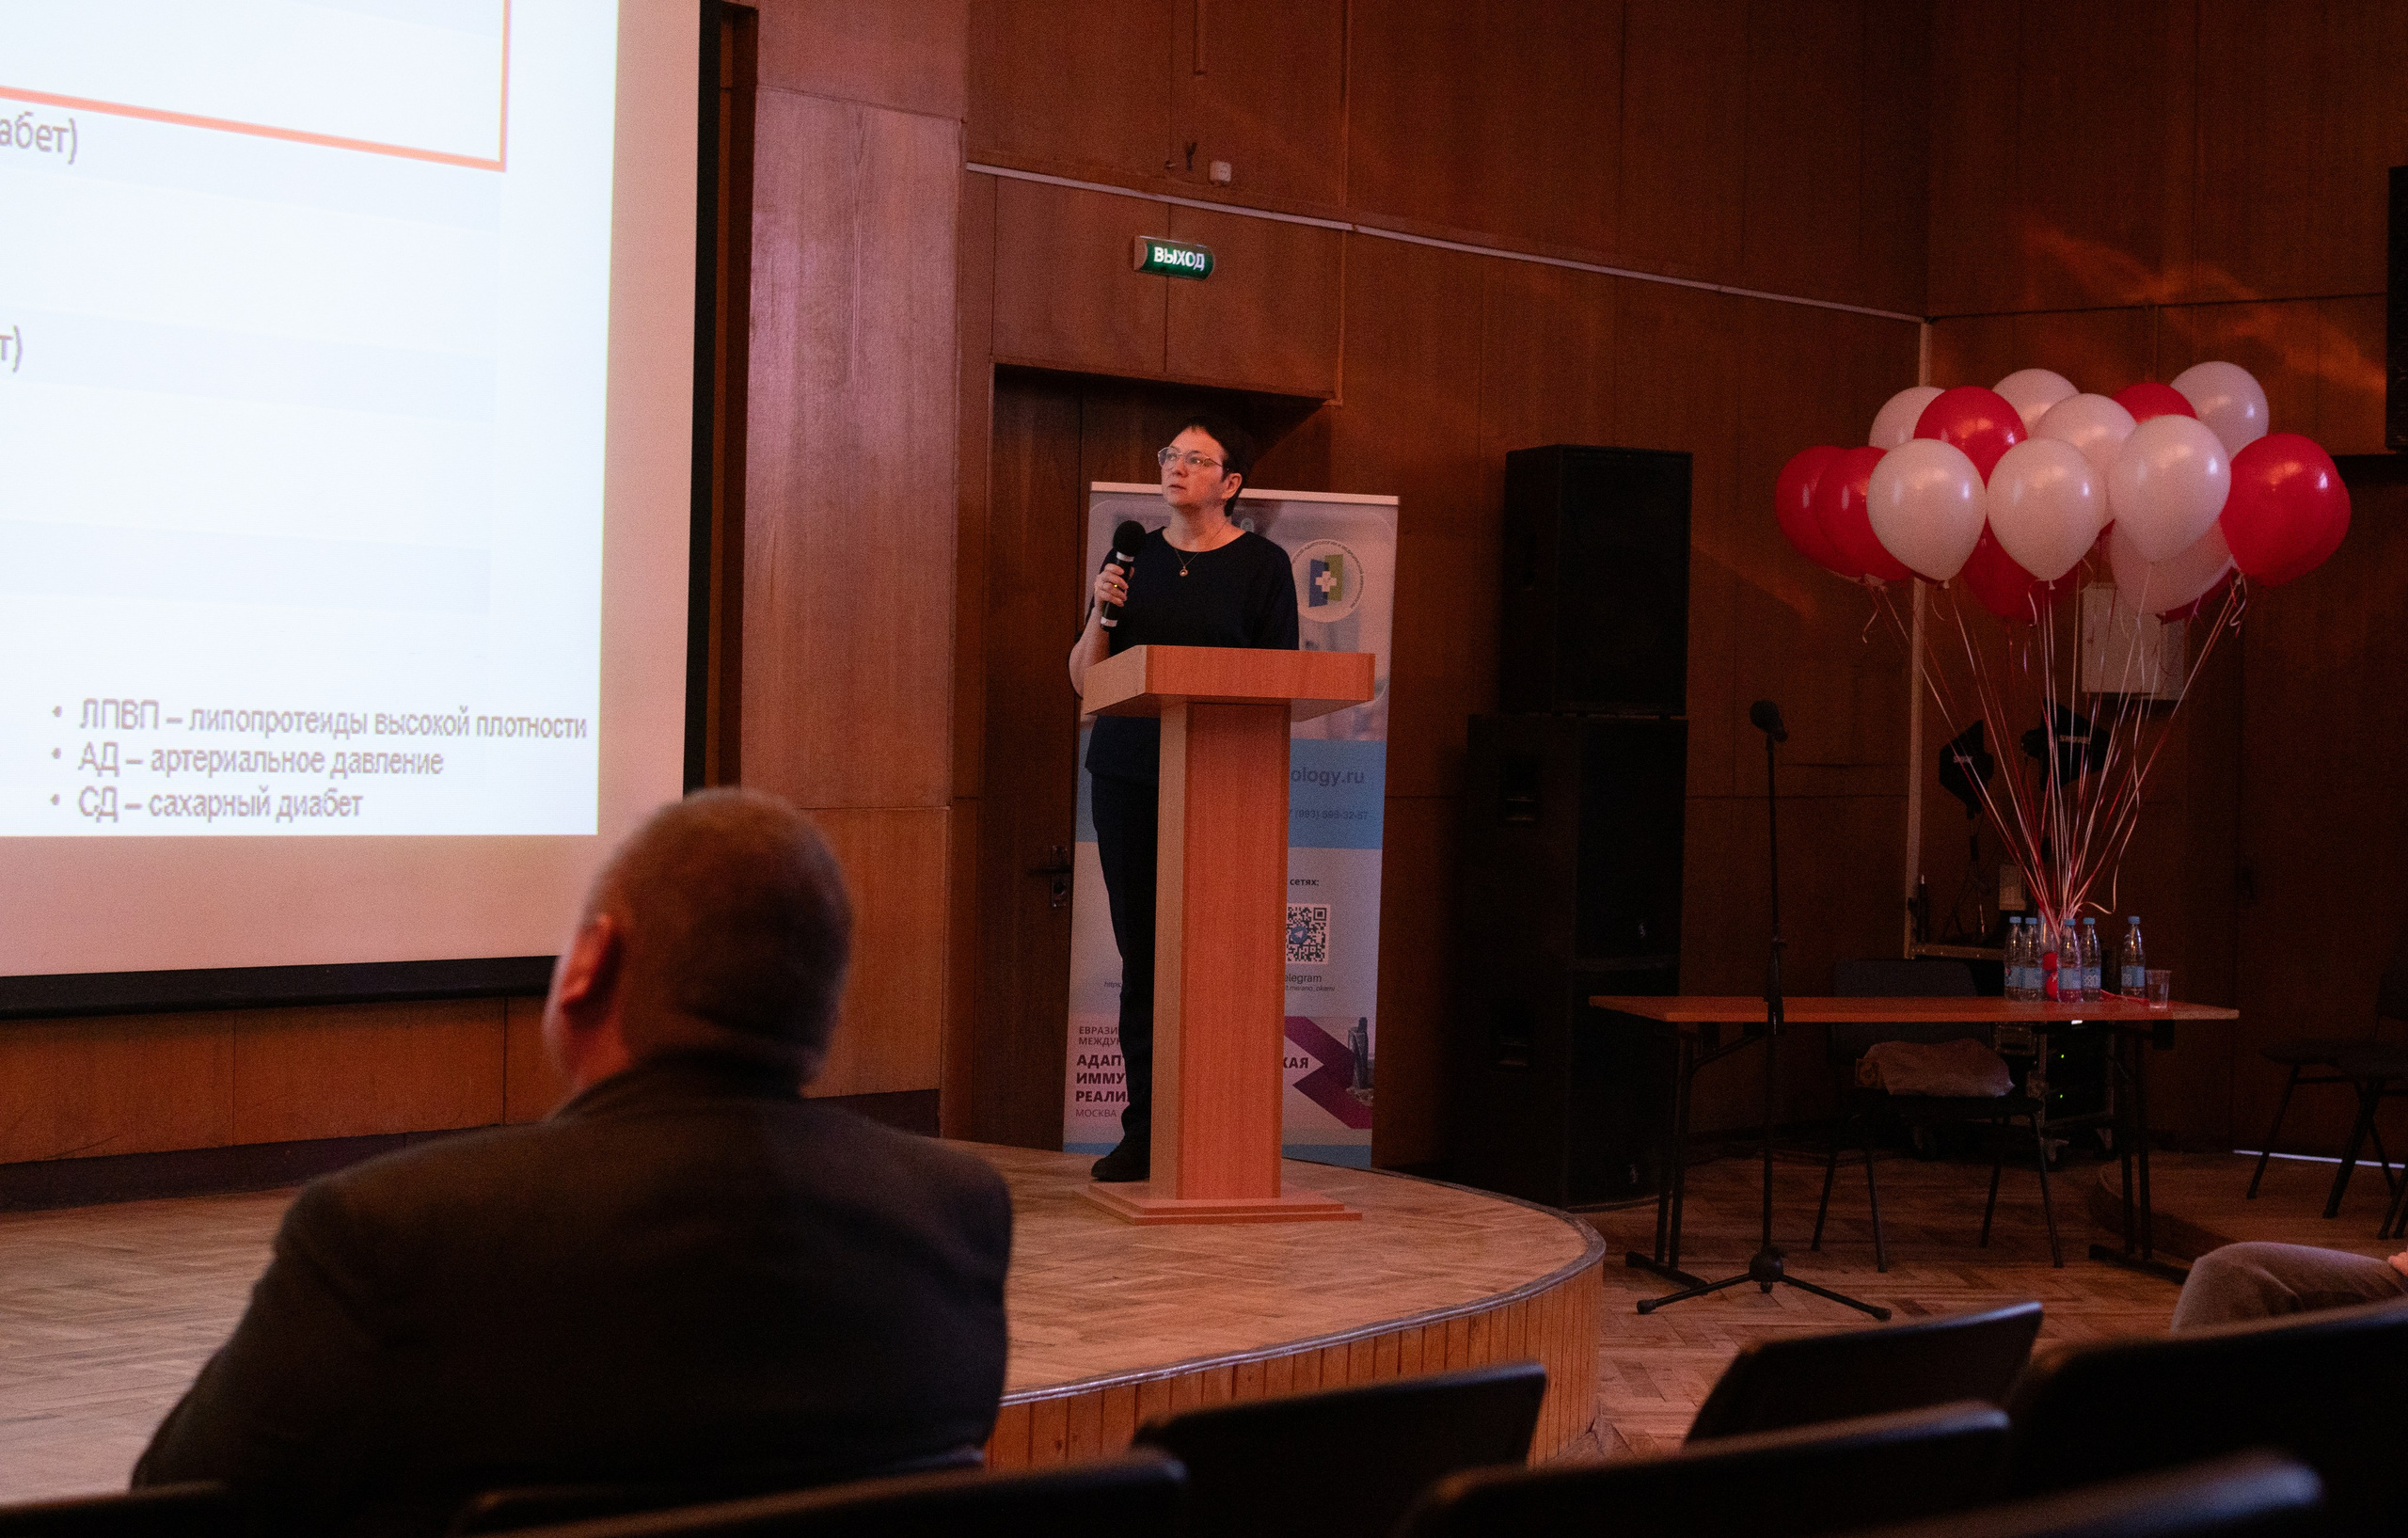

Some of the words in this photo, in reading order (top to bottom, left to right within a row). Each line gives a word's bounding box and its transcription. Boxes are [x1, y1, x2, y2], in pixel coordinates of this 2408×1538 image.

[1153, 246, 1206, 272] ВЫХОД
[80, 698, 160, 730] ЛПВП
[189, 707, 368, 739] липопротеиды
[374, 706, 470, 737] высокой
[476, 714, 588, 739] плотности
[78, 741, 119, 777] АД
[150, 747, 325, 774] артериальное
[329, 752, 444, 779] давление
[1291, 767, 1365, 786] ology.ru
[79, 785, 119, 822] СД
[149, 785, 271, 823] сахарный
[276, 787, 363, 823] диабет
[1076, 1054, 1123, 1069] АДАП
[1076, 1072, 1126, 1085] ИММУ
[1075, 1091, 1129, 1102] РЕАЛИ
[1075, 1109, 1117, 1118] МОСКВА
